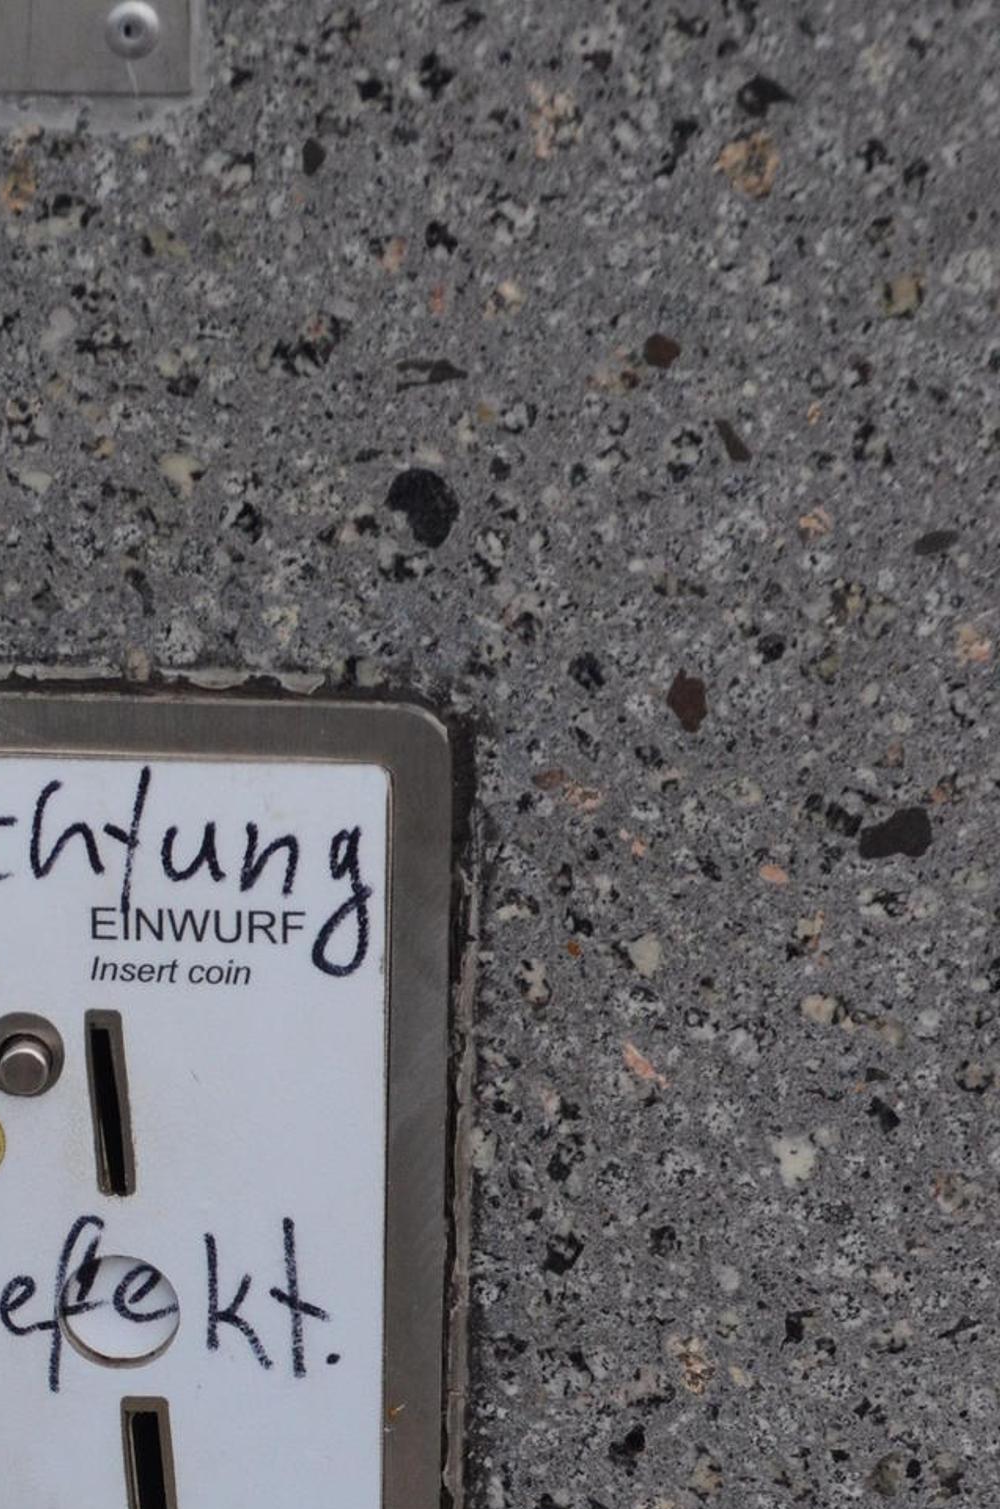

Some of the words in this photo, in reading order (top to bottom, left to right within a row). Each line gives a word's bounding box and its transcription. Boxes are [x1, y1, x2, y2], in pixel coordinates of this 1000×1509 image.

[90, 906, 308, 945] EINWURF
[90, 957, 179, 985] Insert
[188, 962, 252, 986] coin
